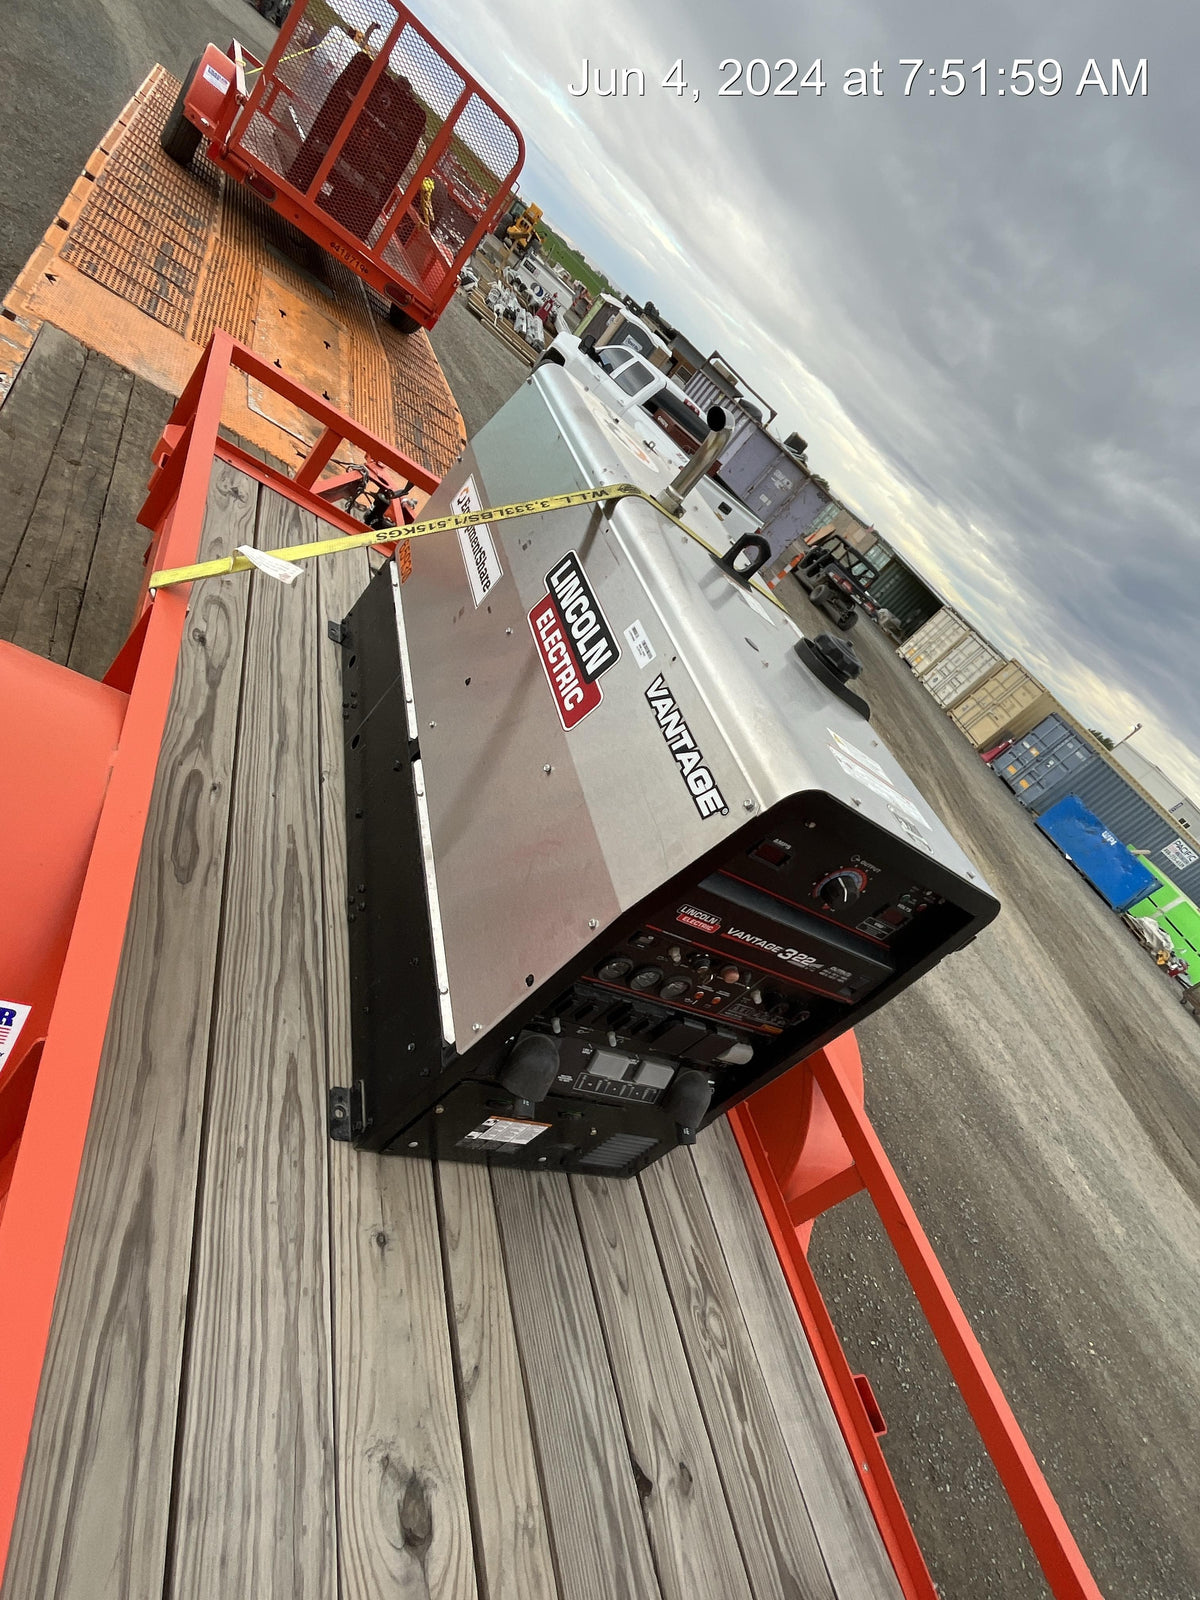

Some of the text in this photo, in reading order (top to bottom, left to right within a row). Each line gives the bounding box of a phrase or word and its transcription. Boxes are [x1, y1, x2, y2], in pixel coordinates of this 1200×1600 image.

[550, 558, 612, 677] LINCOLN
[535, 607, 585, 712] ELECTRIC
[645, 674, 727, 820] VANTAGE
[1174, 840, 1197, 862] PACIFIC
[680, 905, 719, 925] LINCOLN
[681, 915, 714, 932] ELECTRIC
[727, 926, 785, 954] VANTAGE
[777, 948, 817, 967] 322
